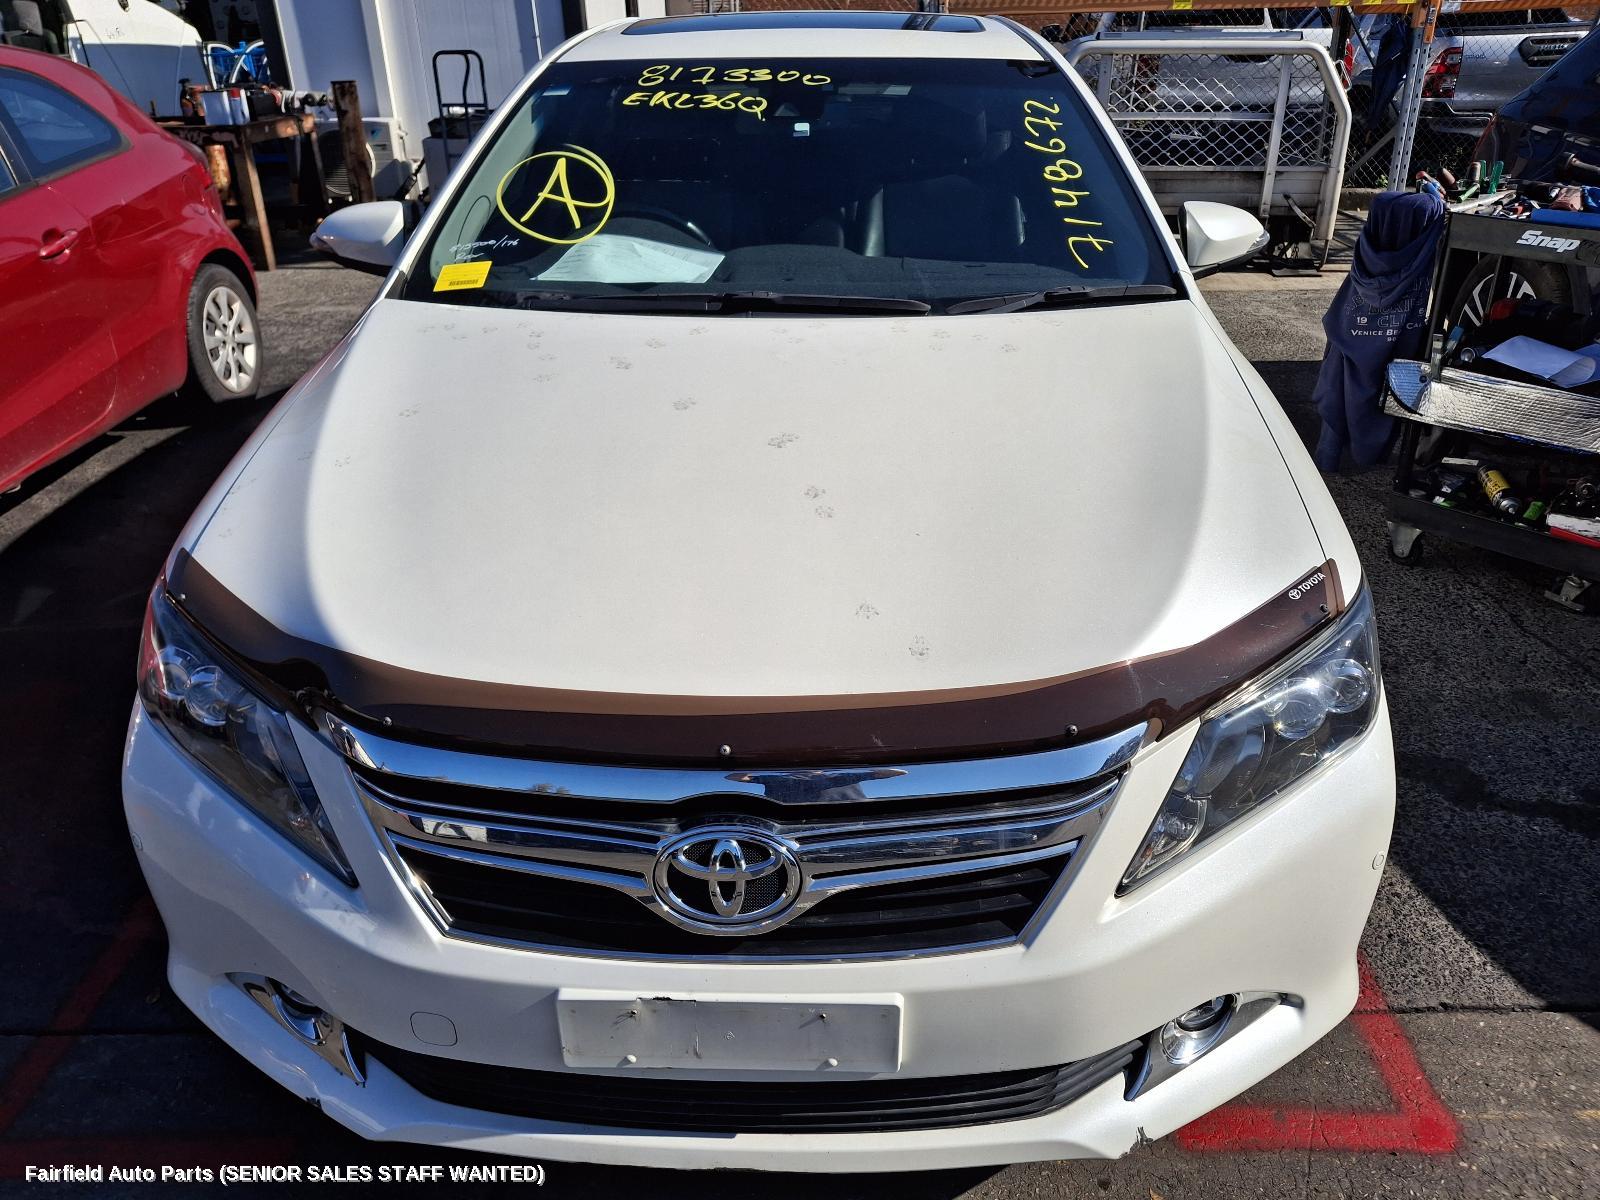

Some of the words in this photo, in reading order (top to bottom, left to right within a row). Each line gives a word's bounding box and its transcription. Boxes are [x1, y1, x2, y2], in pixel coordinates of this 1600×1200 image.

[1516, 229, 1581, 253] Snap
[1356, 316, 1368, 324] 19
[1297, 572, 1326, 592] TOYOTA
